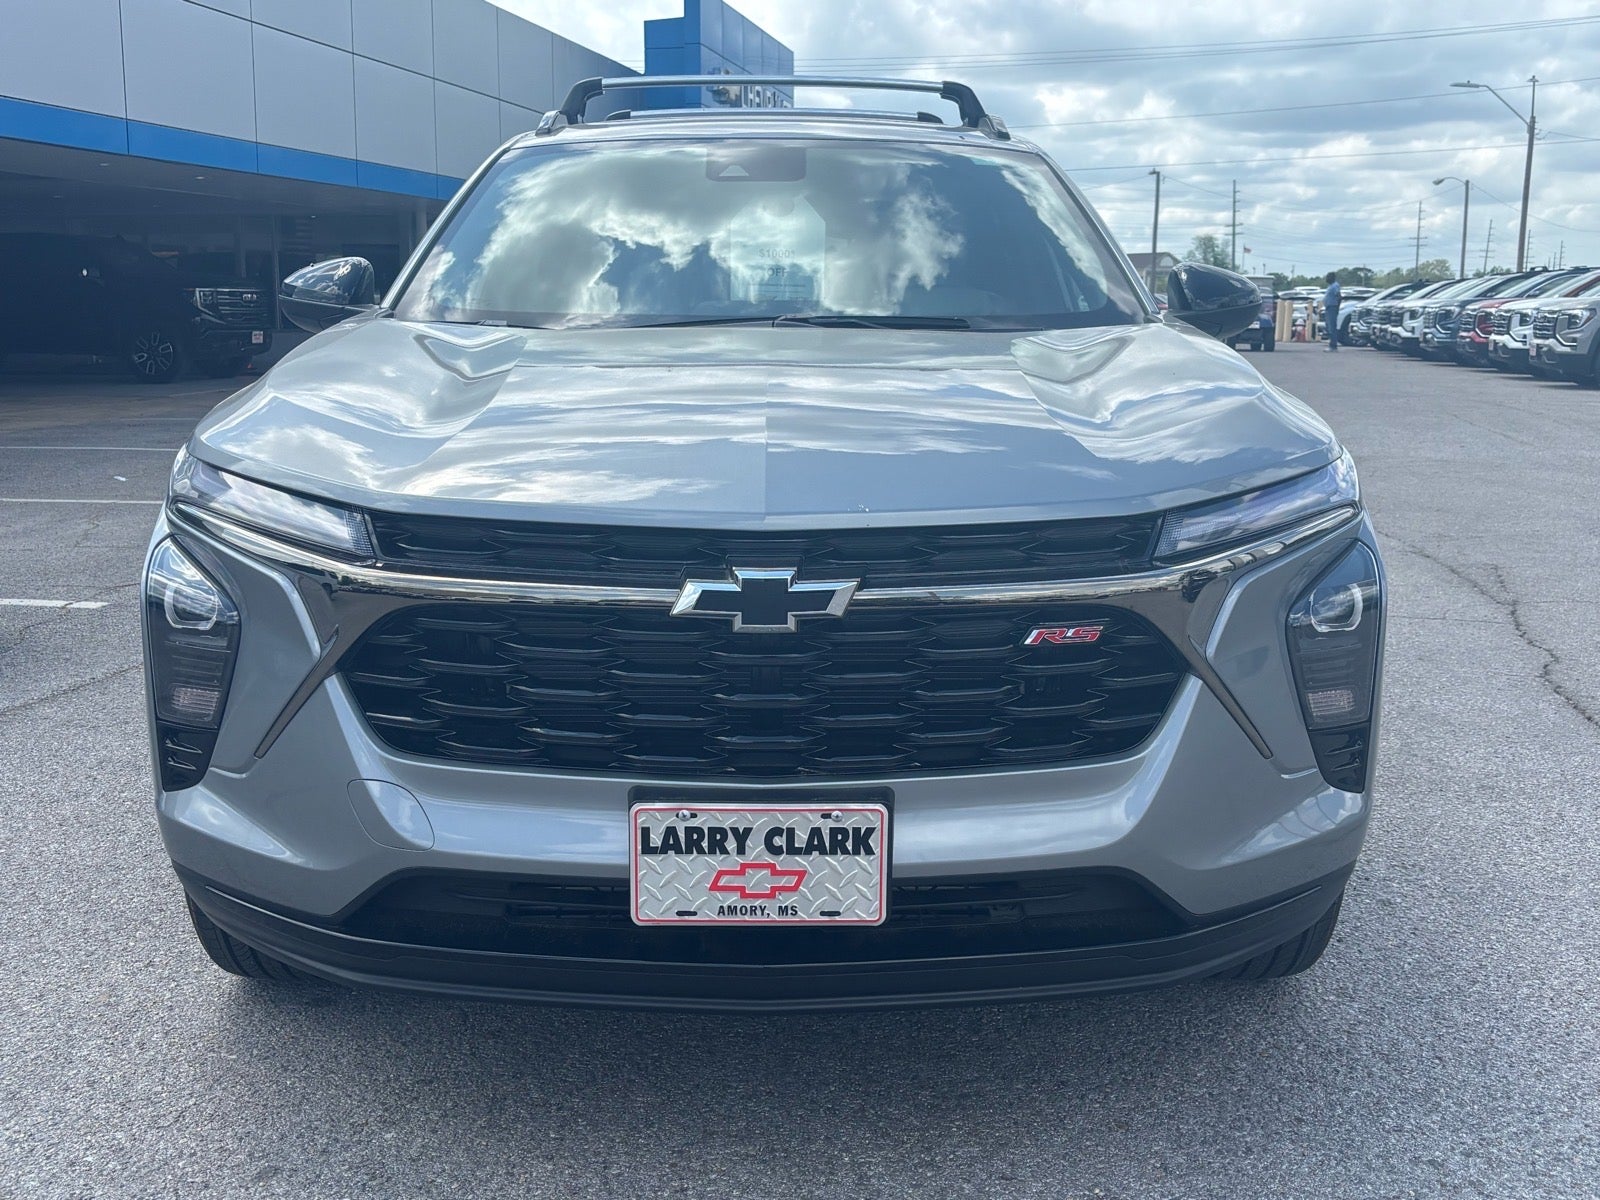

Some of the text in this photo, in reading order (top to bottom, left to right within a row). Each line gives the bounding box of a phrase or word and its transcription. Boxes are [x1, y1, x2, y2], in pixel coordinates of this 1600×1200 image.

[766, 267, 787, 277] OFF
[1023, 626, 1104, 645] RS
[640, 826, 877, 856] LARRY CLARK
[717, 905, 798, 918] AMORY, MS
